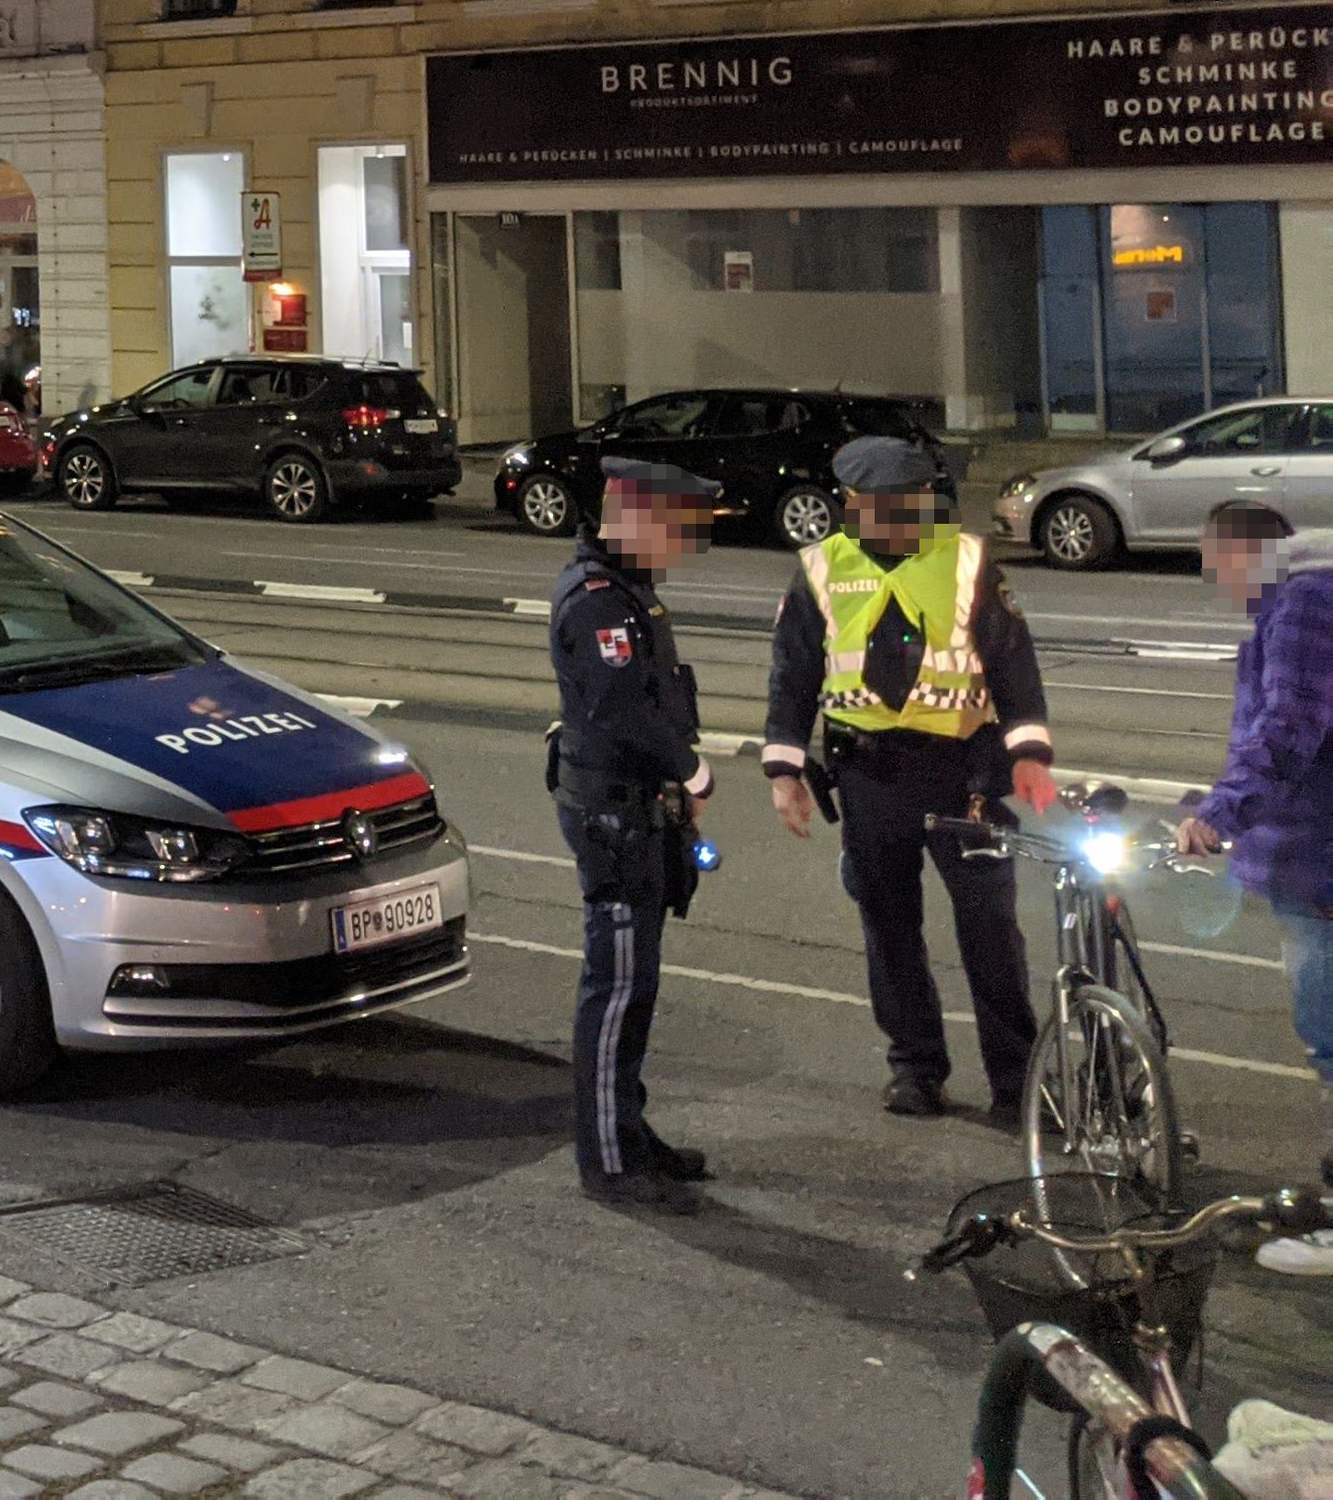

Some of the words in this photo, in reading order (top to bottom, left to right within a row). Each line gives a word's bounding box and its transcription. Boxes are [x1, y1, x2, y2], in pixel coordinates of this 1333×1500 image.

[1067, 36, 1162, 59] HAARE
[601, 56, 793, 93] BRENNIG
[1138, 60, 1298, 85] SCHMINKE
[1104, 90, 1333, 118] BODYPAINTING
[1118, 121, 1325, 147] CAMOUFLAGE
[459, 151, 503, 164] HAARE
[524, 148, 597, 162] PERÜCKEN
[615, 146, 692, 161] SCHMINKE
[710, 143, 831, 159] BODYPAINTING
[848, 138, 965, 154] CAMOUFLAGE
[828, 579, 879, 594] POLIZEI
[154, 712, 318, 754] POLIZEI
[351, 909, 371, 941] BP
[384, 893, 434, 933] 90928
